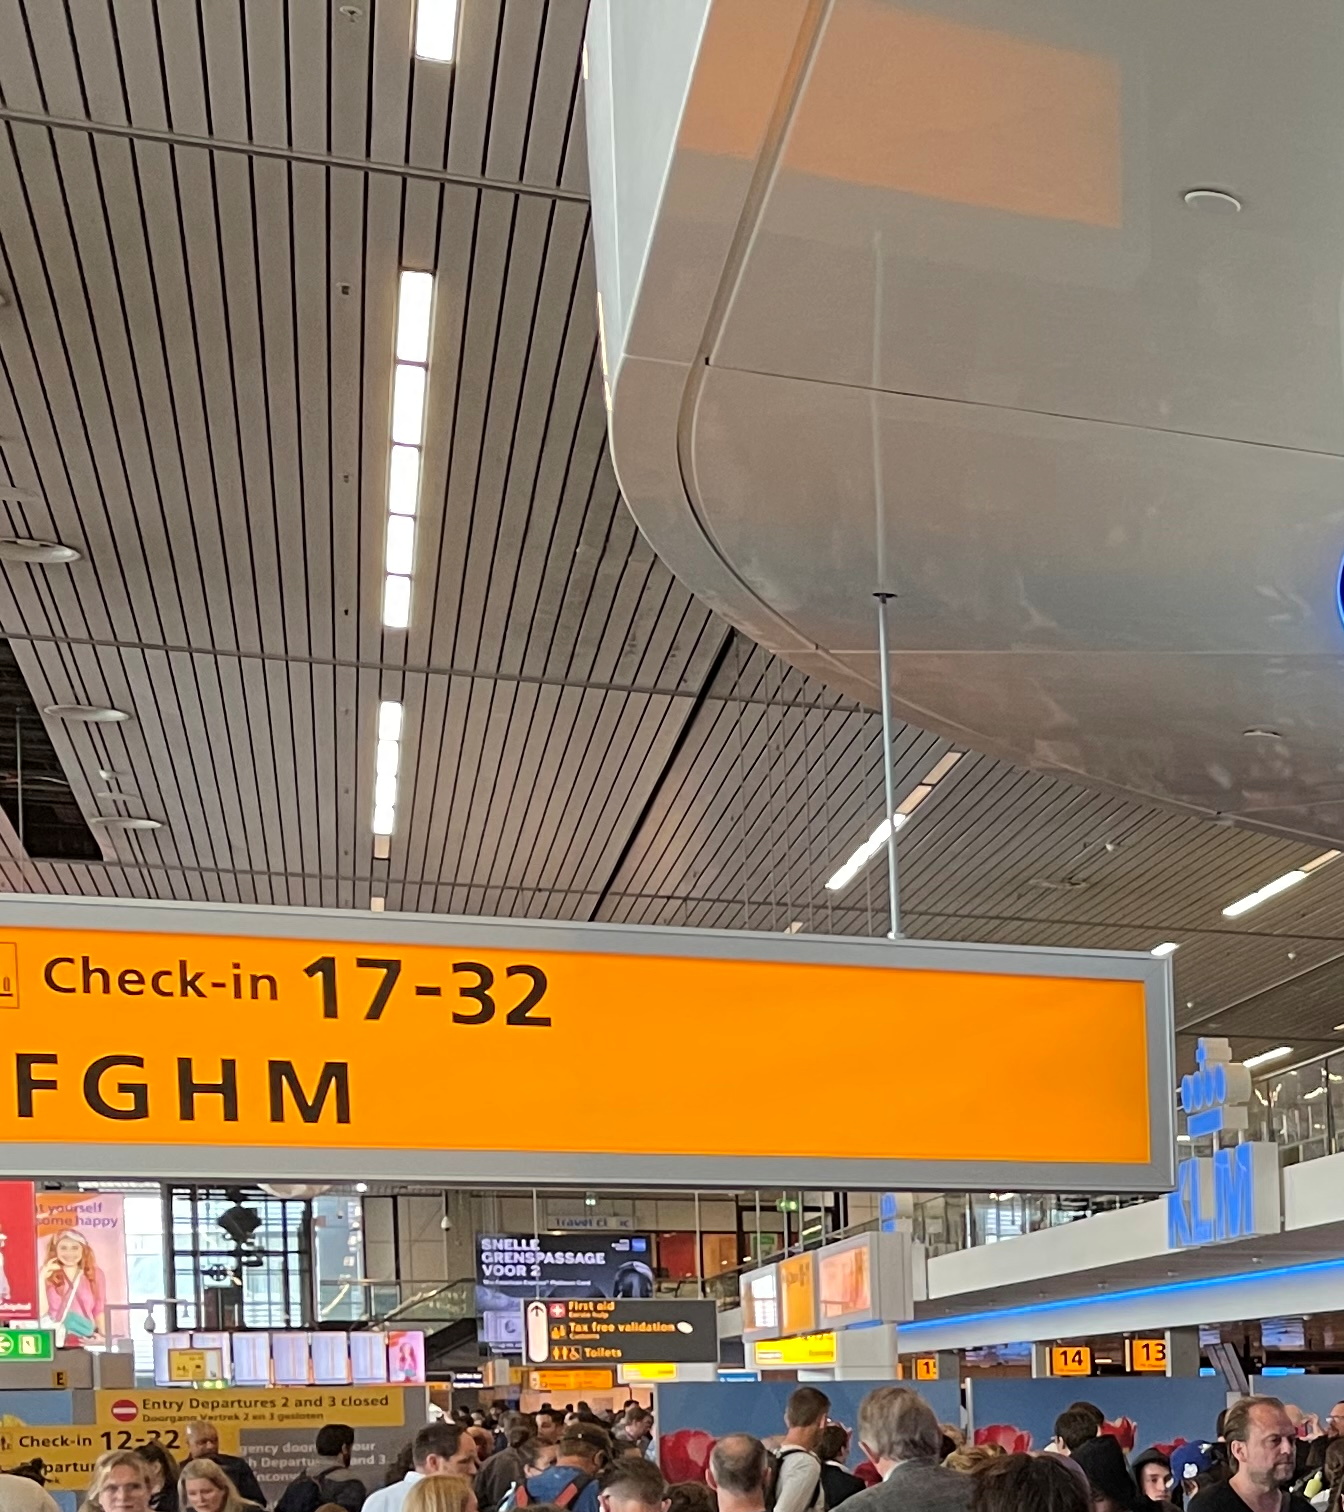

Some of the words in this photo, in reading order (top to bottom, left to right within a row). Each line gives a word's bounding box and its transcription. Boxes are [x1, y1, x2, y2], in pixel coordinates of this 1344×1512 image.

[44, 956, 278, 1000] Check-in
[303, 957, 552, 1027] 17-32
[1168, 1141, 1254, 1249] KLM
[49, 1202, 102, 1215] yourself
[75, 1216, 118, 1228] happy
[481, 1238, 540, 1251] SNELLE
[481, 1252, 606, 1265] GRENSPASSAGE
[482, 1264, 526, 1277] VOOR
[530, 1264, 541, 1277] 2
[568, 1301, 594, 1311] First
[596, 1301, 615, 1311] aid
[569, 1322, 589, 1332] Tax
[618, 1321, 676, 1333] validation
[584, 1347, 622, 1358] Toilets
[1060, 1350, 1083, 1366] 14
[1141, 1343, 1166, 1361] 13
[56, 1372, 65, 1386] E
[142, 1398, 183, 1412] Entry
[189, 1397, 276, 1411] Departures
[281, 1397, 289, 1408] 2
[295, 1395, 323, 1407] and
[328, 1396, 336, 1407] 3
[341, 1395, 389, 1406] closed
[19, 1434, 92, 1447] Check-in
